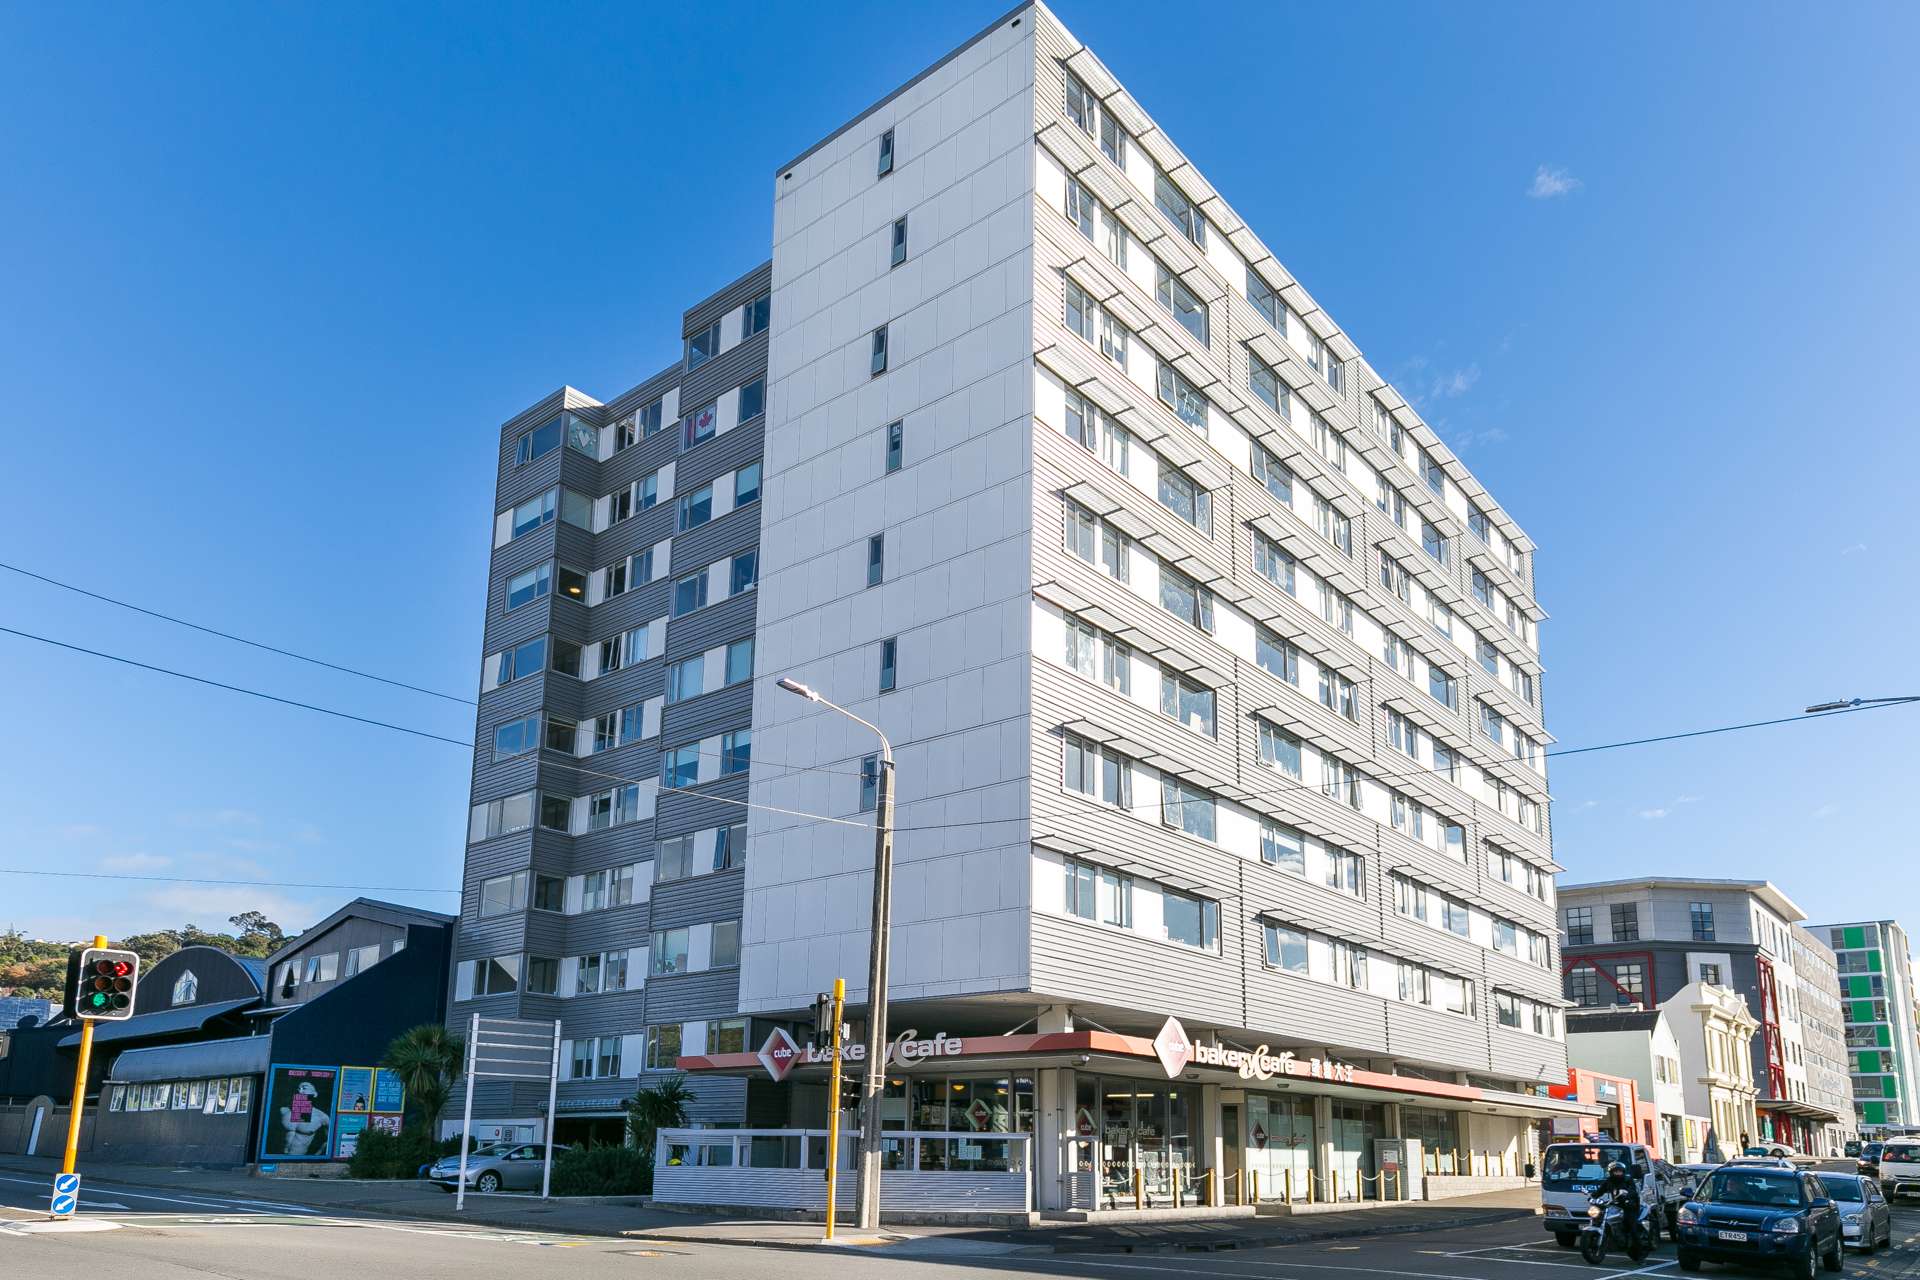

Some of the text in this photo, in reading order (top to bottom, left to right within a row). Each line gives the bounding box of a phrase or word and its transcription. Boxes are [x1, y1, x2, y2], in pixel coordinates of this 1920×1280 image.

[773, 1047, 792, 1059] cube
[807, 1031, 963, 1067] bakey cafe
[1195, 1039, 1256, 1079] bakery
[1104, 1124, 1135, 1137] bakery
[1719, 1231, 1746, 1241] ETR452
